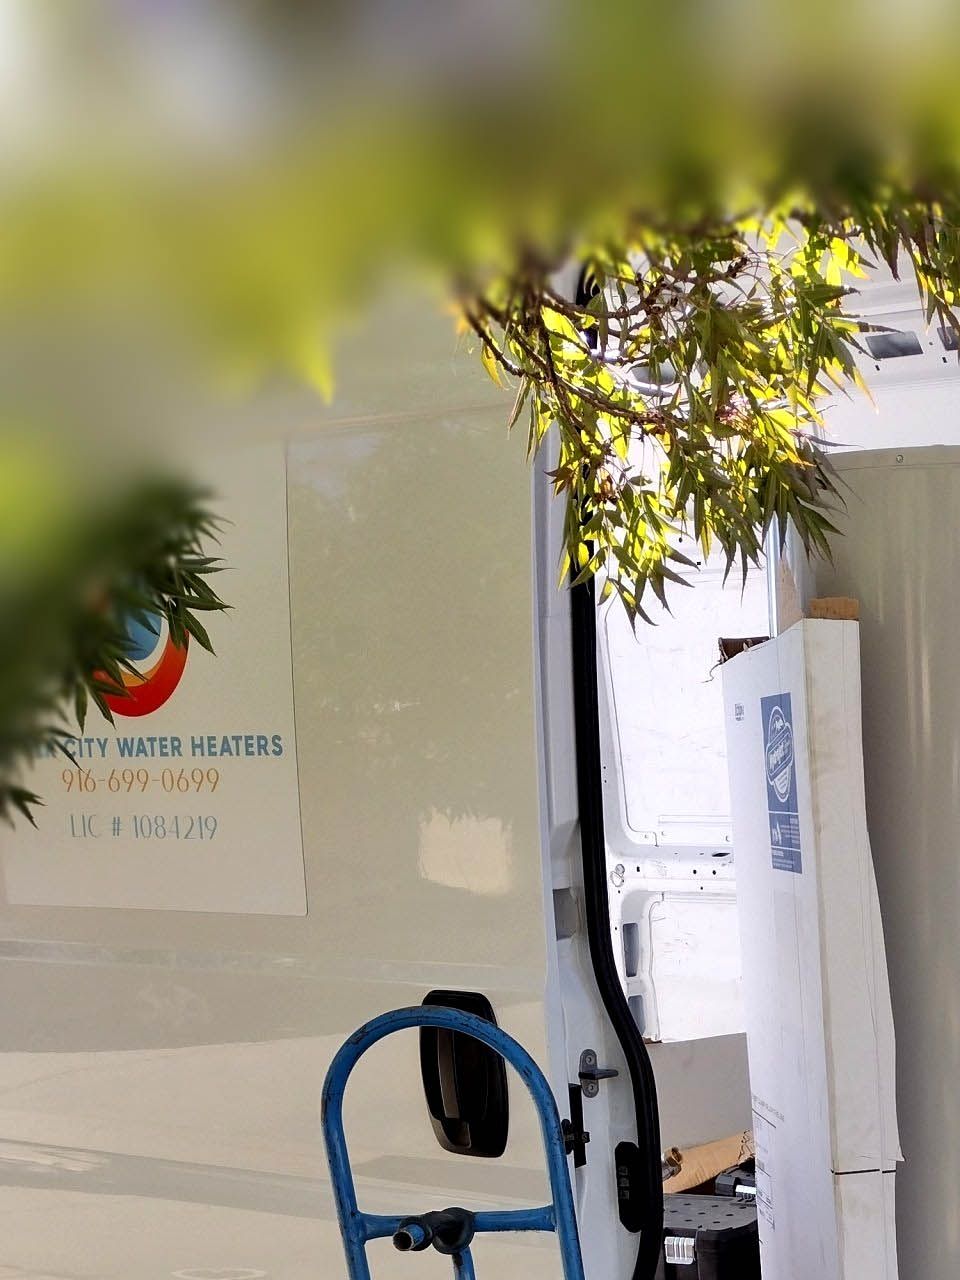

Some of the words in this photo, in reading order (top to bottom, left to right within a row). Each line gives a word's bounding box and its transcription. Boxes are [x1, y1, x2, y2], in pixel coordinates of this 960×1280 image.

[116, 736, 183, 758] WATER
[190, 734, 284, 757] HEATERS
[61, 767, 220, 793] 916-699-0699
[70, 814, 101, 838] LIC
[111, 815, 123, 837] #
[133, 815, 218, 840] 1084219
